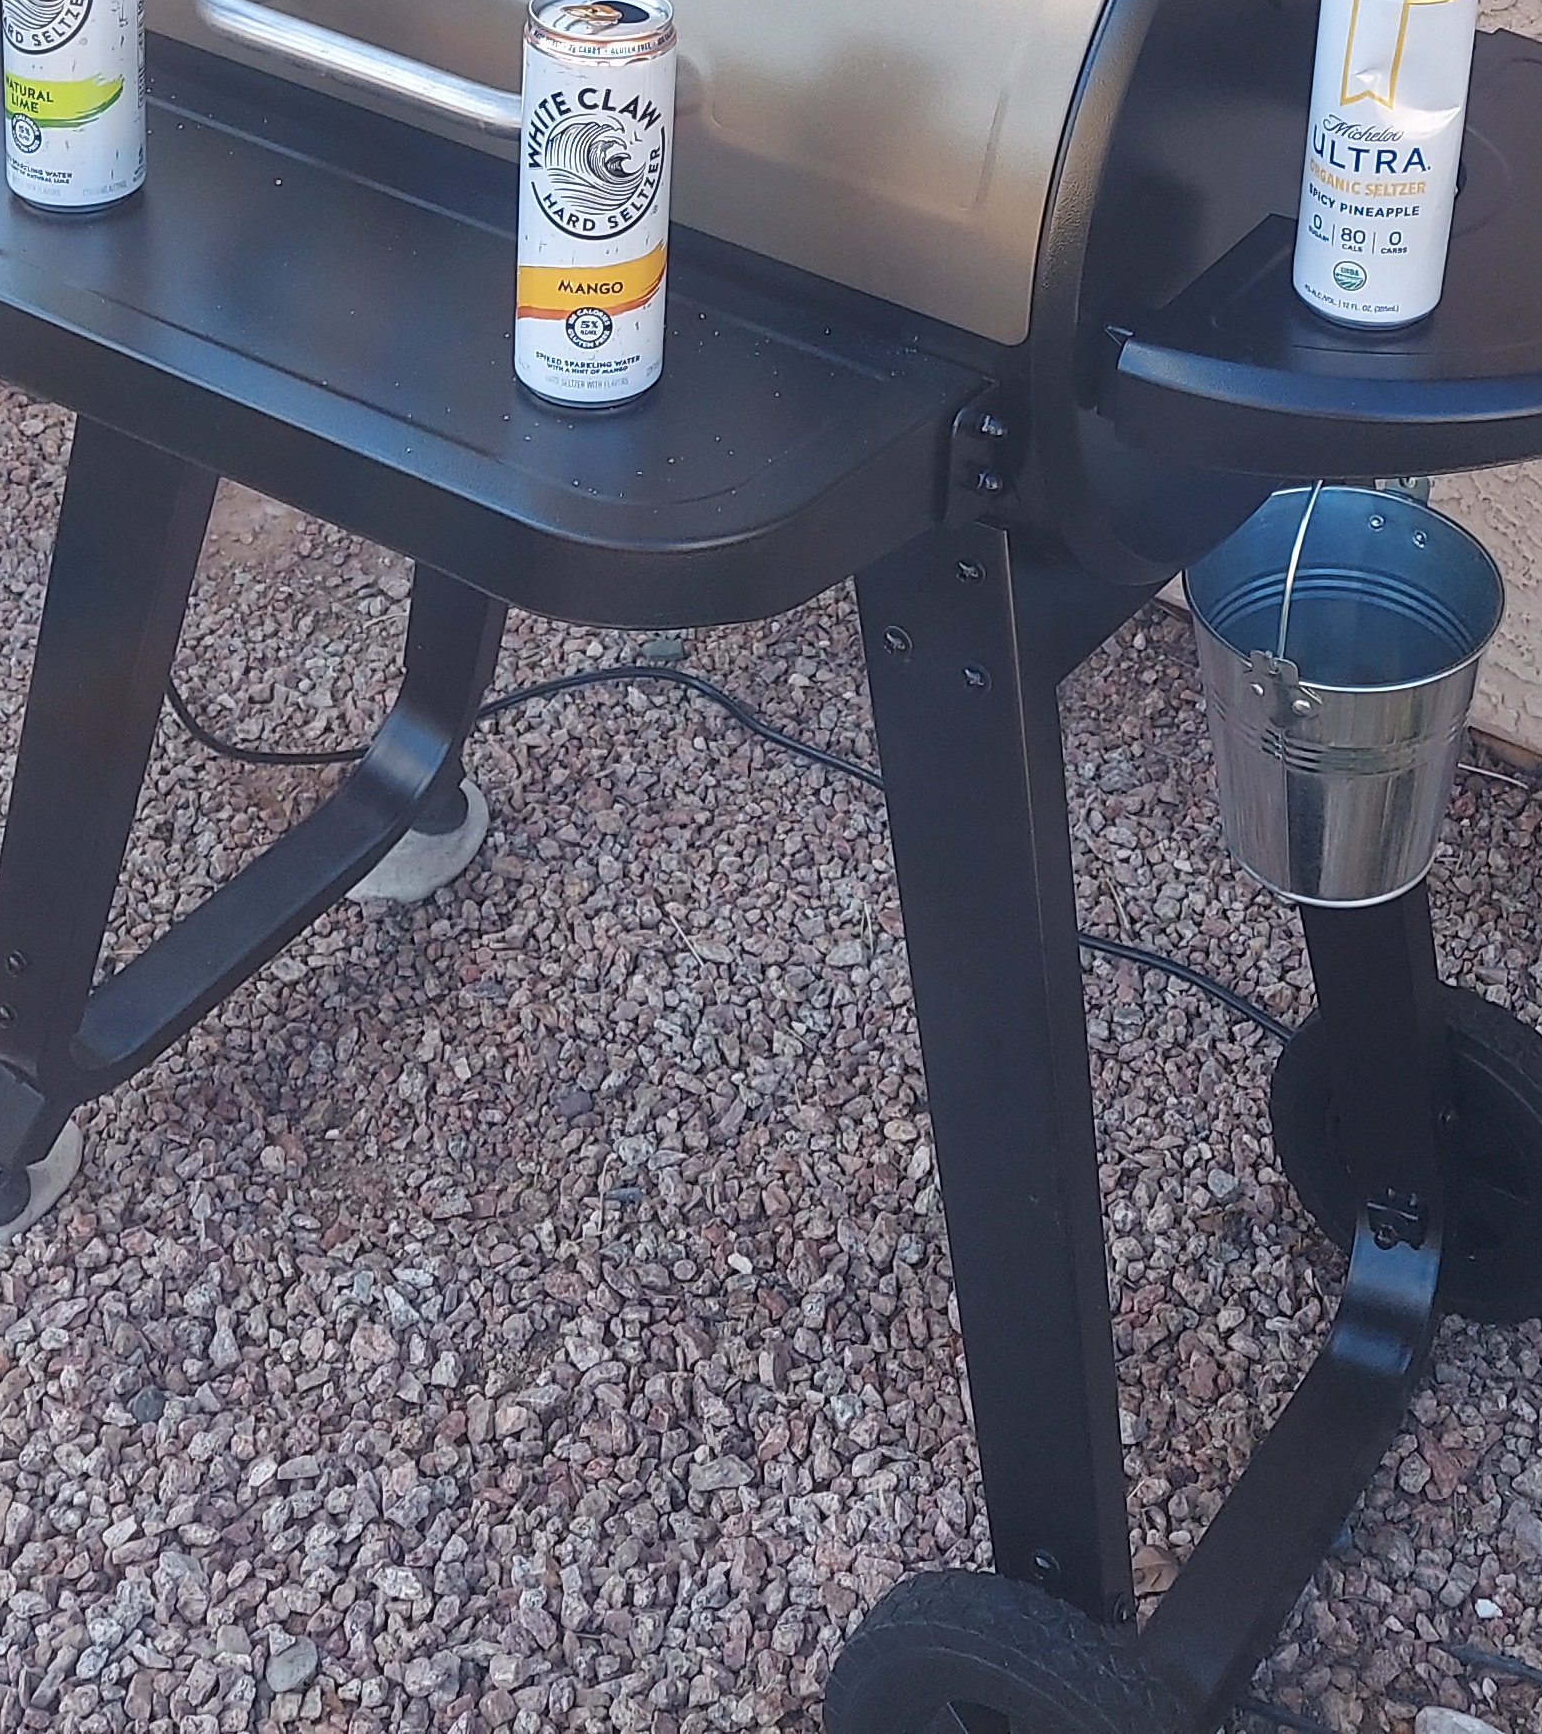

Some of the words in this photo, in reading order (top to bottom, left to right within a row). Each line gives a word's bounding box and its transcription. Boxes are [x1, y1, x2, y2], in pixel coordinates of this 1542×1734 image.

[11, 93, 39, 114] LIME
[527, 91, 572, 170] WHITE
[577, 87, 661, 131] CLAW
[1310, 158, 1361, 195] ORGANIC
[1365, 181, 1426, 197] SELTZER
[542, 192, 596, 232] HARD
[607, 146, 661, 229] SELTZER
[1309, 183, 1336, 209] SPICY
[1340, 202, 1420, 218] PINEAPPLE
[1313, 214, 1322, 230] 0
[1341, 227, 1366, 245] 80
[1389, 231, 1402, 246] 0
[1341, 243, 1363, 253] CALS
[1380, 246, 1408, 255] CARBS
[558, 279, 624, 295] MANGO
[535, 351, 562, 365] SPIKED
[564, 359, 612, 369] SPARKLING
[613, 354, 641, 367] WATER
[601, 365, 629, 375] MANGO
